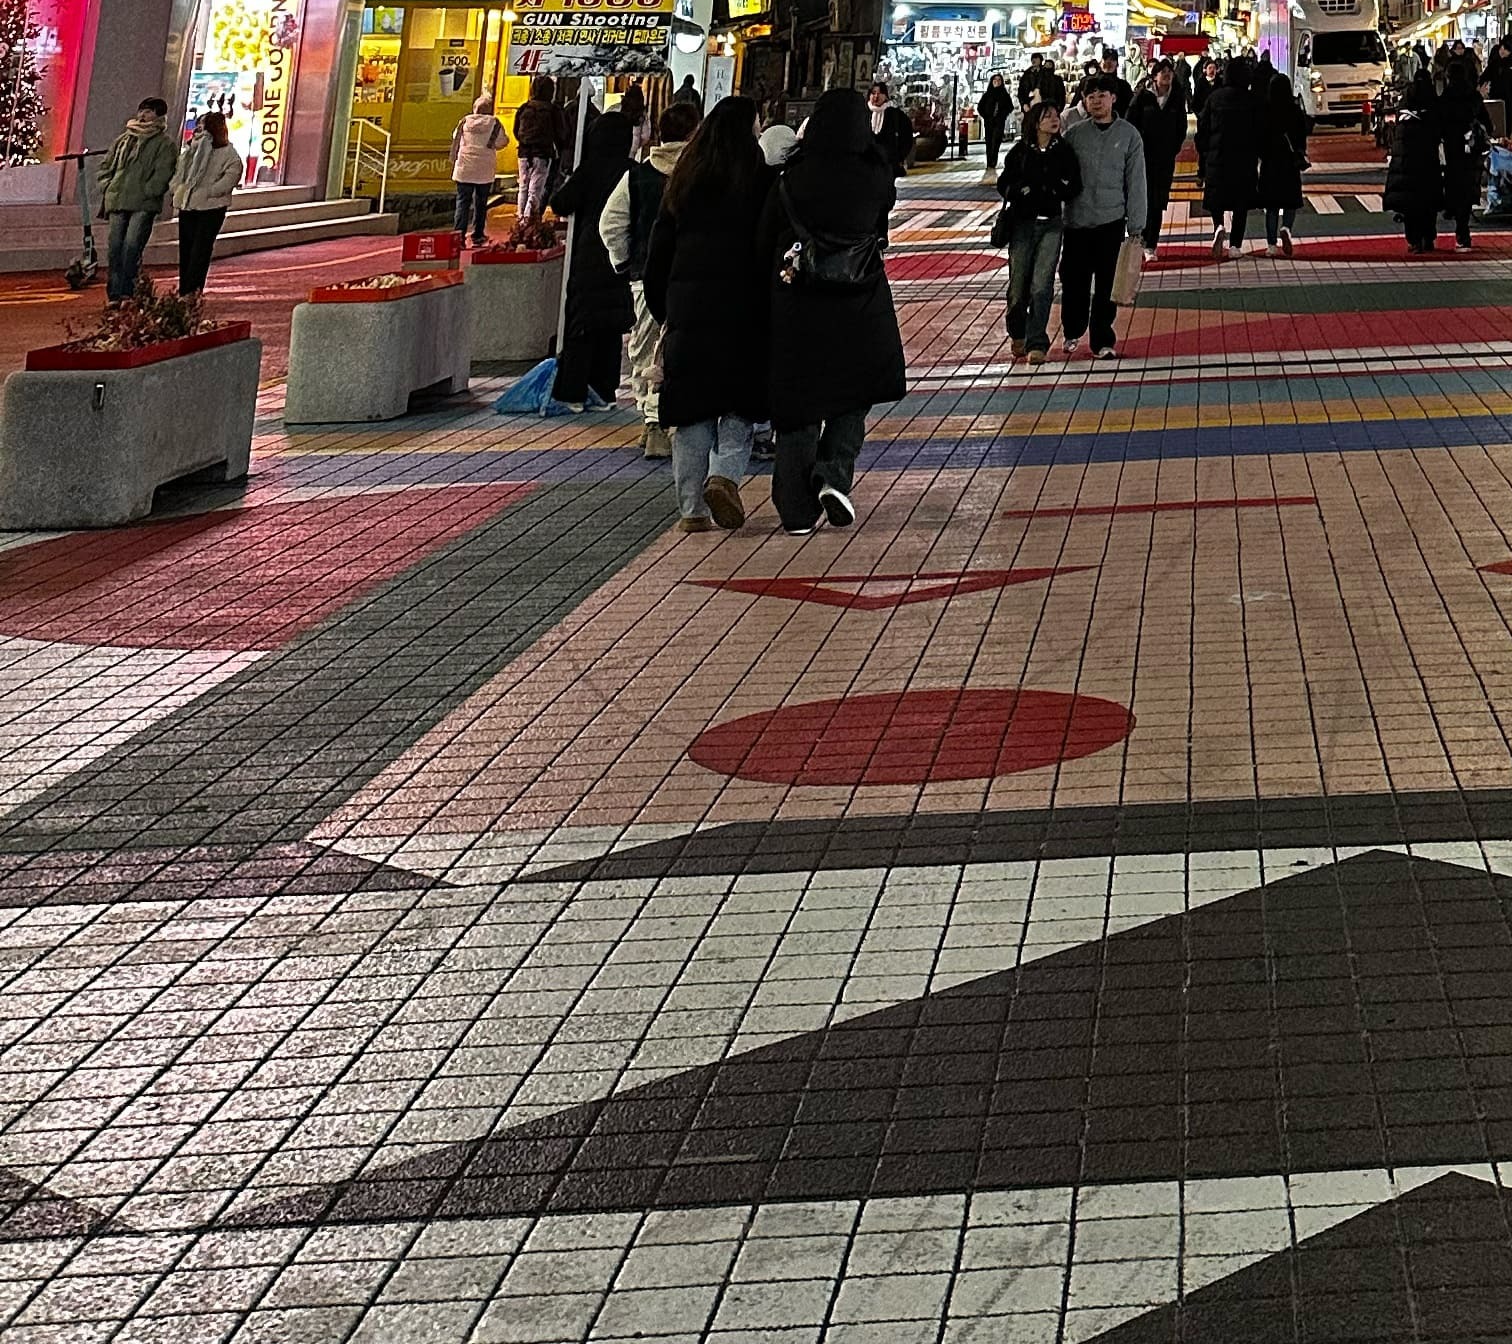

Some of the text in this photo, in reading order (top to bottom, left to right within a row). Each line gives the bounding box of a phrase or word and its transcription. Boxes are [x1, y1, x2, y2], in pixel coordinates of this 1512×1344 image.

[522, 13, 660, 28] GUN Shooting
[514, 49, 552, 73] 4F
